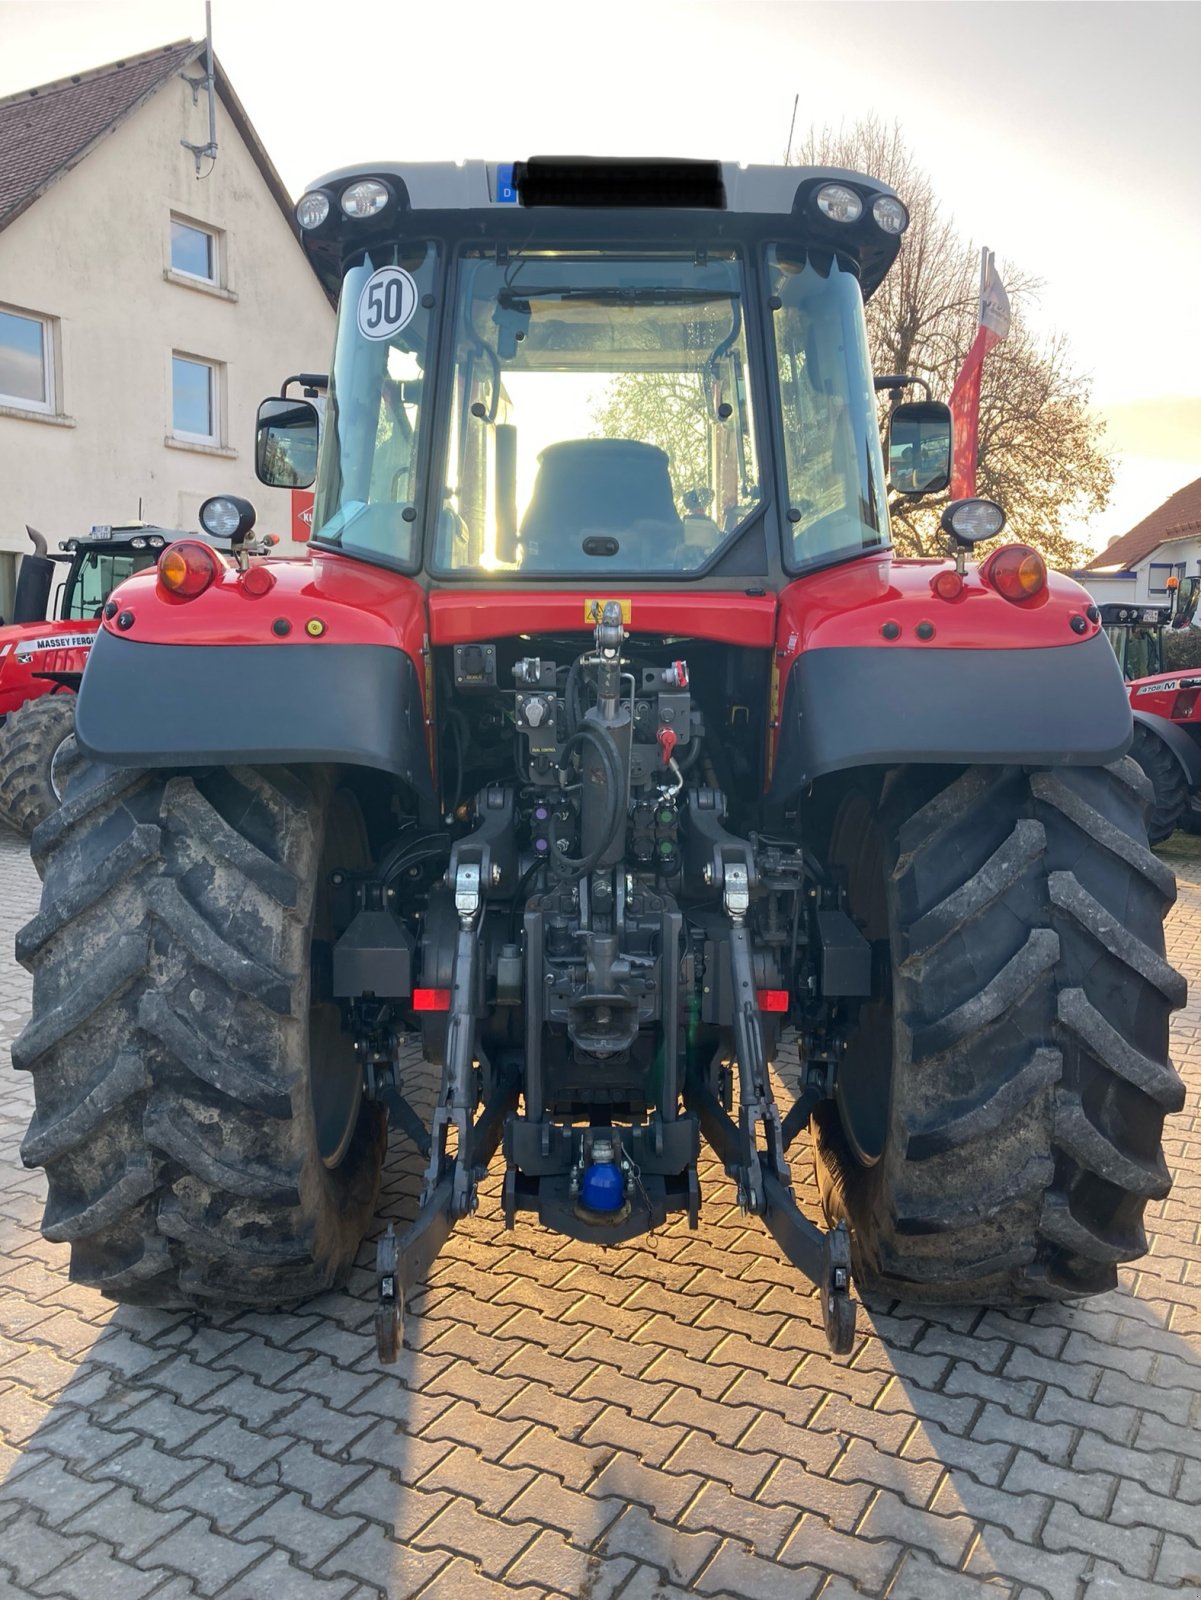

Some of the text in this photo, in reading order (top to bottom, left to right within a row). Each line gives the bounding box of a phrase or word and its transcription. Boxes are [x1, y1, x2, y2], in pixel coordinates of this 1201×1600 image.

[504, 188, 511, 197] D
[366, 277, 403, 329] 50
[37, 638, 70, 649] MASSEY
[1164, 681, 1176, 690] M
